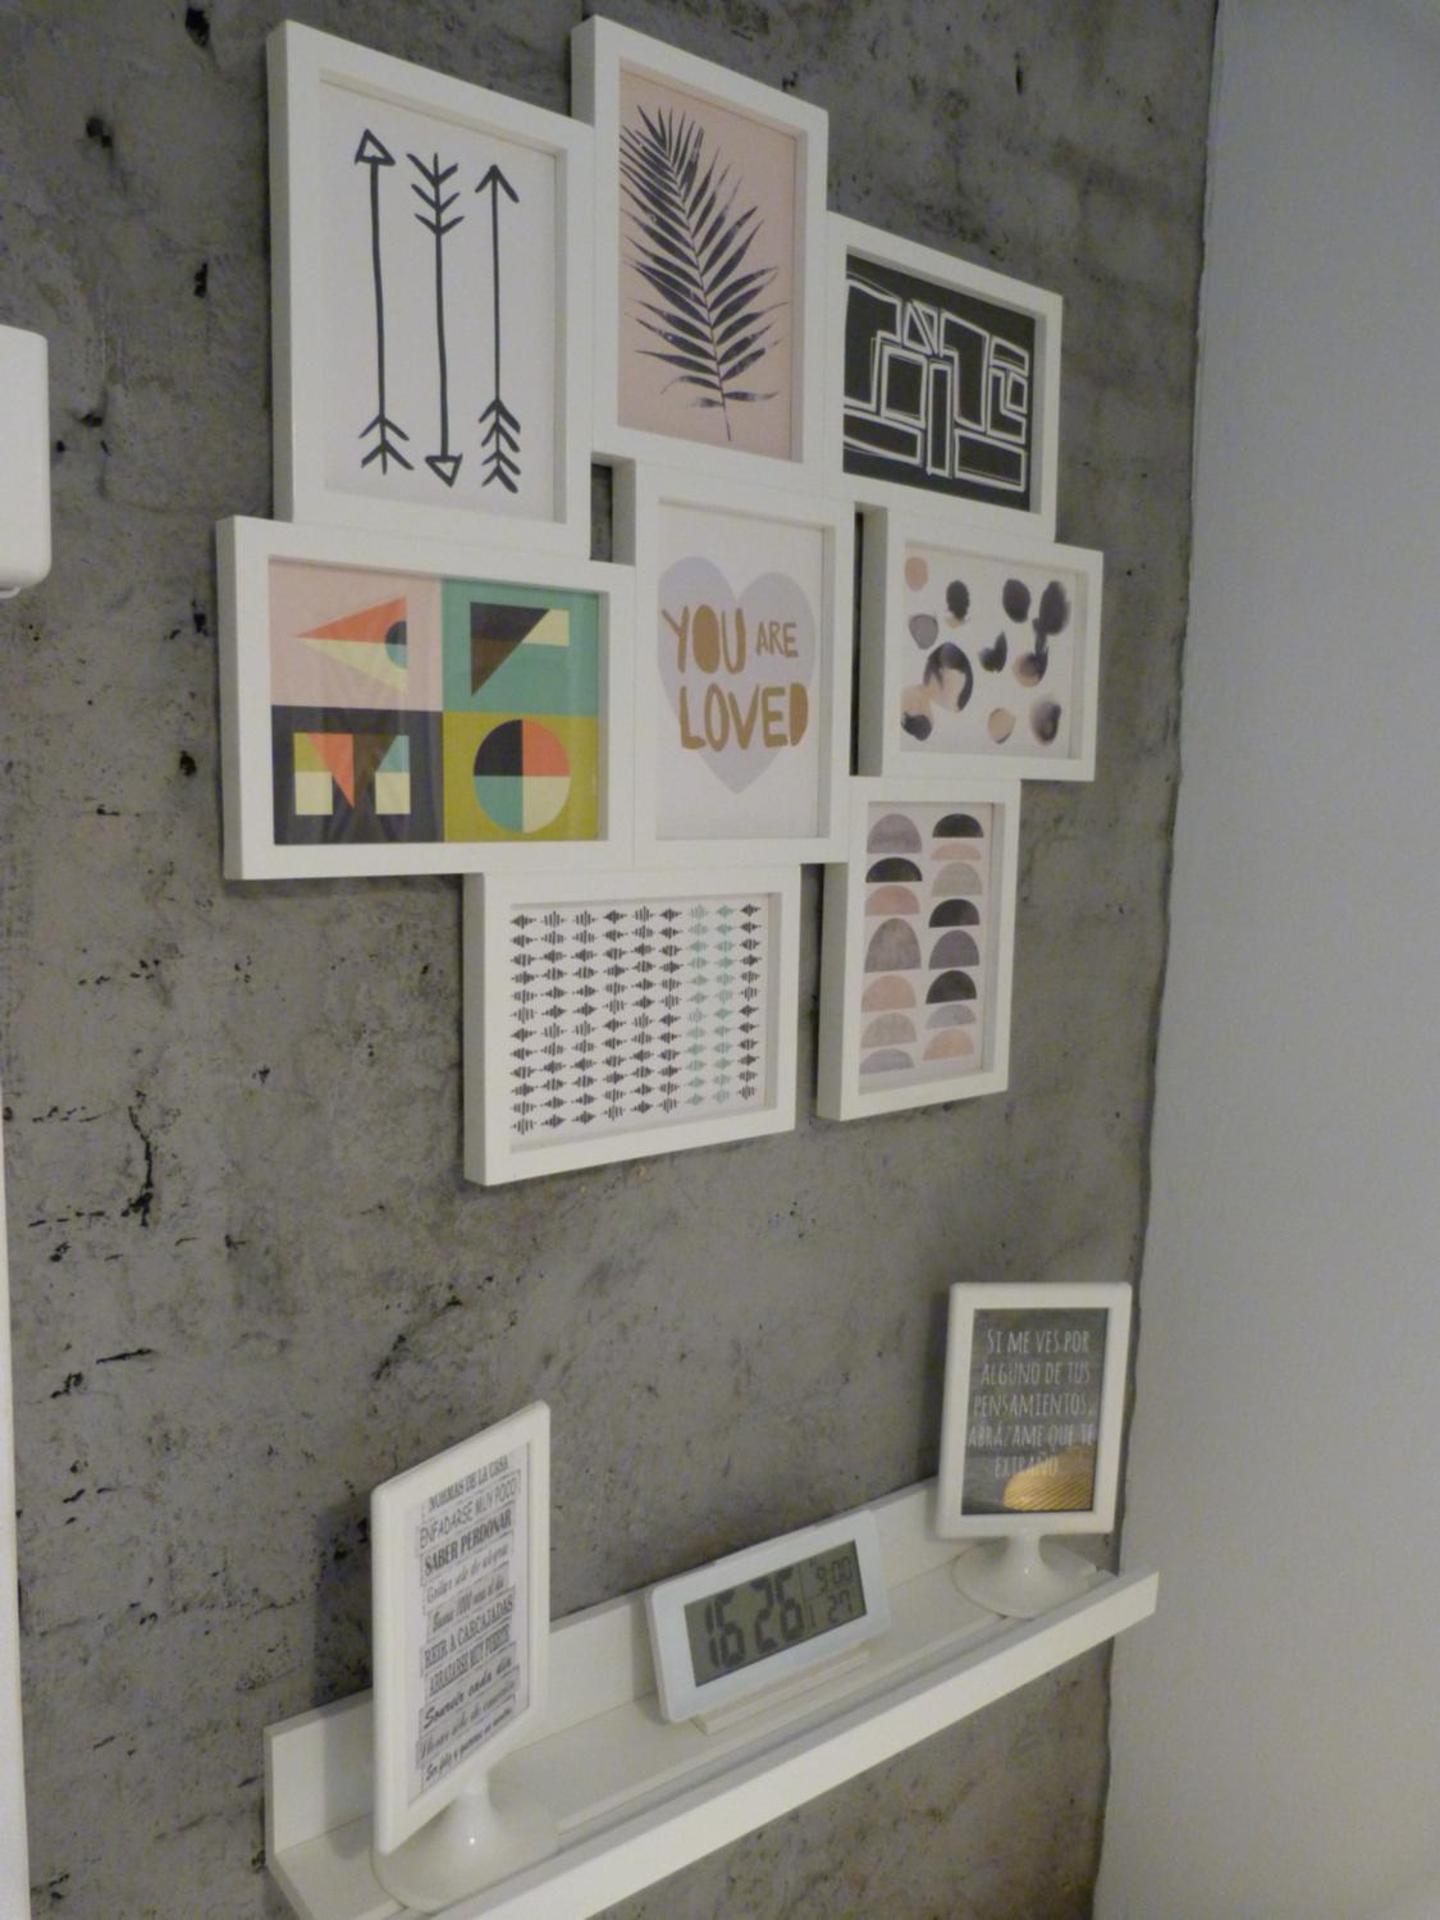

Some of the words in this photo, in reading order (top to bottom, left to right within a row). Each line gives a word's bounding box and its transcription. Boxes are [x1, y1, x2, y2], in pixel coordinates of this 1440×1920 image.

[661, 604, 746, 674] YOU
[757, 621, 800, 658] ARE
[679, 682, 808, 751] LOVED
[1007, 1330, 1030, 1353] ME
[1035, 1330, 1060, 1353] VES
[1064, 1330, 1090, 1353] POR
[981, 1361, 1041, 1386] ALGUNO
[1045, 1361, 1061, 1385] DE
[1067, 1360, 1090, 1384] TUS
[419, 1500, 473, 1549] ENFADARSE
[425, 1541, 458, 1577] SABER
[460, 1508, 512, 1555] PERDONAR
[458, 1594, 513, 1649] CARCAJADAS
